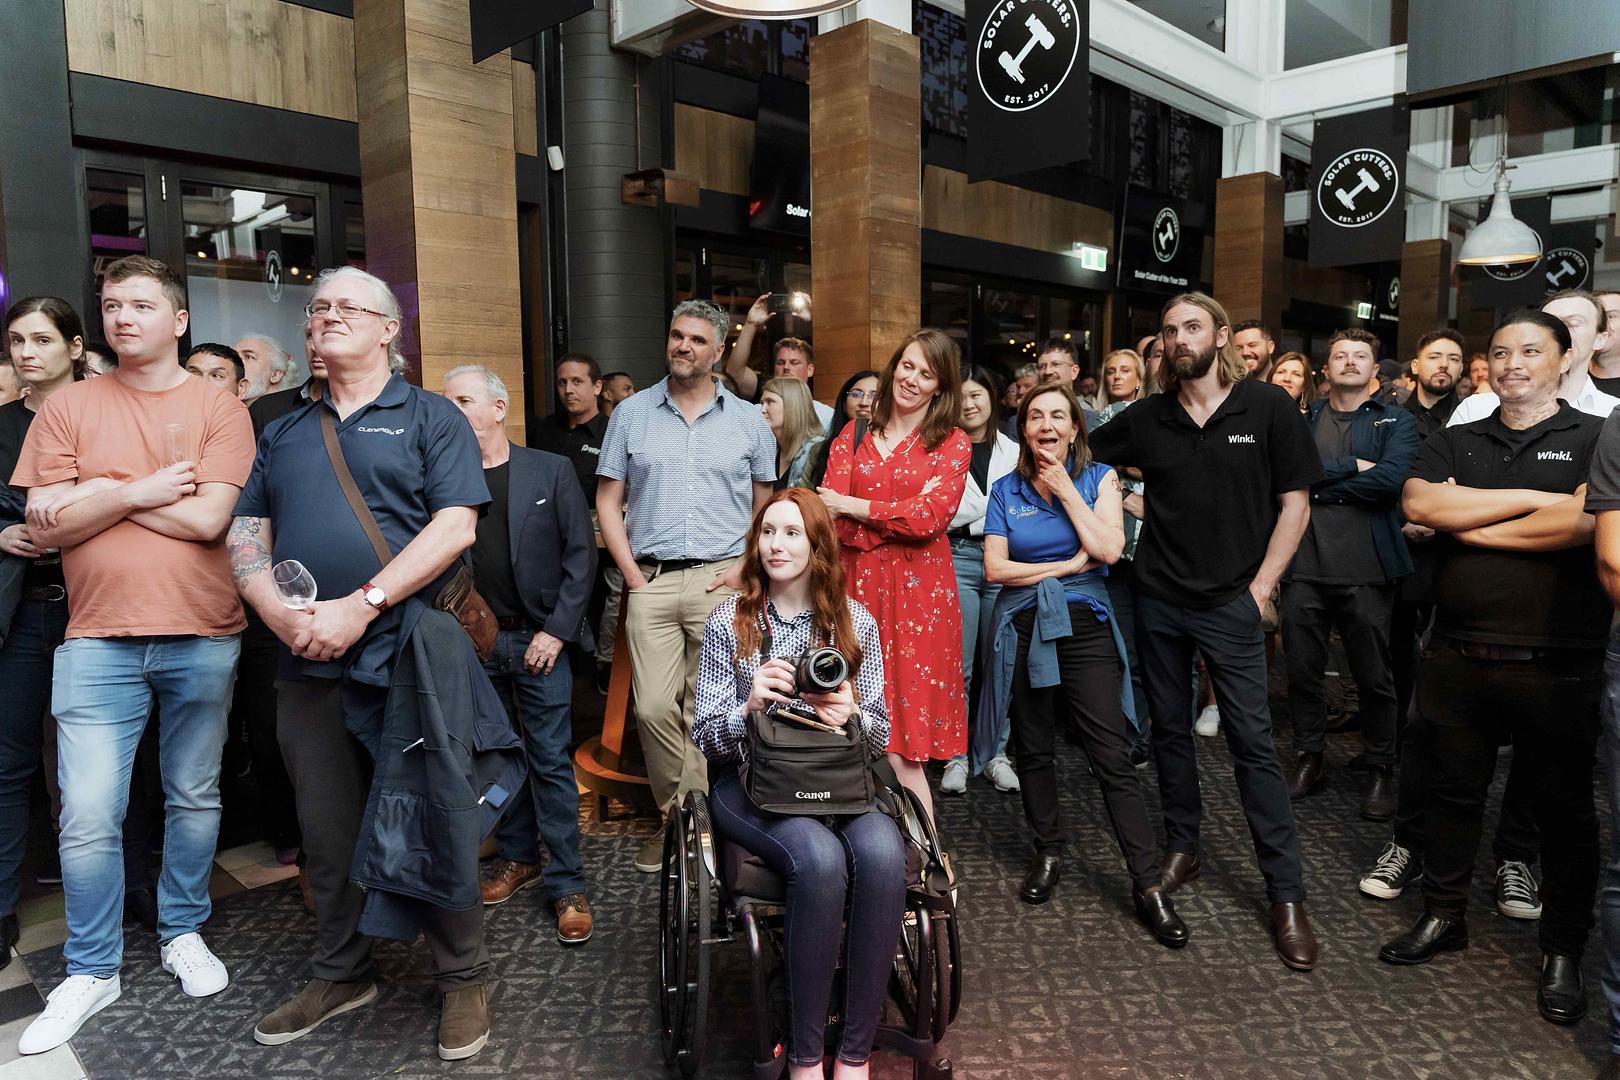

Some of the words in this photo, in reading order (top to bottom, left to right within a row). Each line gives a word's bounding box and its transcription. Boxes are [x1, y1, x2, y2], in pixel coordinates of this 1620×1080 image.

[983, 0, 1016, 49] SOLAR
[1004, 95, 1024, 104] EST.
[1028, 83, 1050, 102] 2017
[1324, 158, 1350, 186] SOLAR
[1354, 153, 1392, 180] CUTTERS.
[786, 203, 809, 218] Solar
[1338, 215, 1354, 223] EST.
[1356, 211, 1374, 222] 2017
[795, 791, 831, 802] Canon
